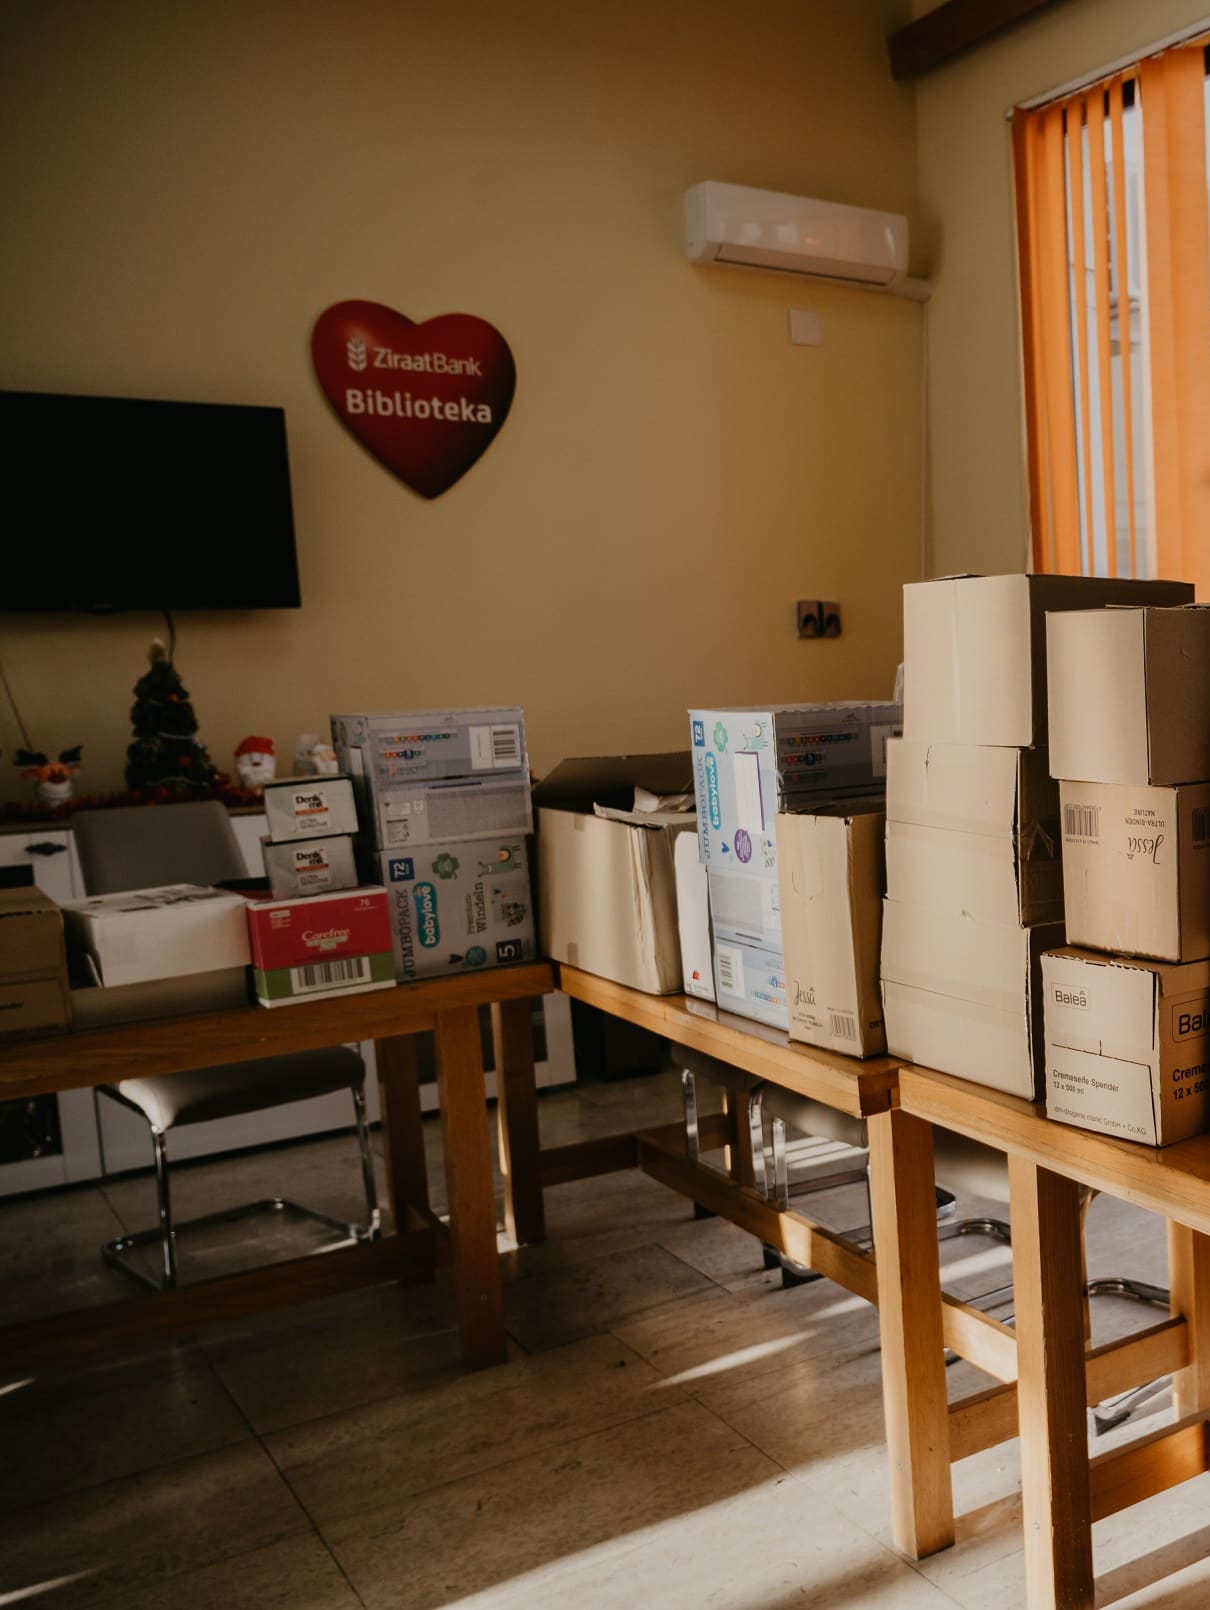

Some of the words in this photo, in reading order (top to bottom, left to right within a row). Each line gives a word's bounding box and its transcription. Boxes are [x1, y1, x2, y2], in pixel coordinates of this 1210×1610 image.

[373, 347, 482, 376] ZiraatBank
[346, 389, 492, 423] Biblioteka
[295, 794, 321, 804] Denk
[710, 757, 720, 827] babylove
[1134, 809, 1155, 817] NATURE
[1124, 818, 1165, 828] ULTRA-BINDEN
[296, 851, 321, 862] Denk
[1127, 834, 1165, 864] Jessa
[394, 862, 406, 879] 72
[422, 885, 436, 944] babylove
[473, 882, 488, 934] Windeln
[302, 928, 350, 942] Carefree
[396, 888, 416, 977] JUMBOPACK
[500, 945, 516, 958] 5
[1055, 990, 1087, 1007] Balea
[1053, 1069, 1090, 1086] Cremeseife
[1091, 1078, 1120, 1093] Spender
[1053, 1081, 1060, 1089] 12
[1065, 1084, 1076, 1093] 500
[1173, 1087, 1183, 1100] 12
[1187, 1088, 1191, 1096] x
